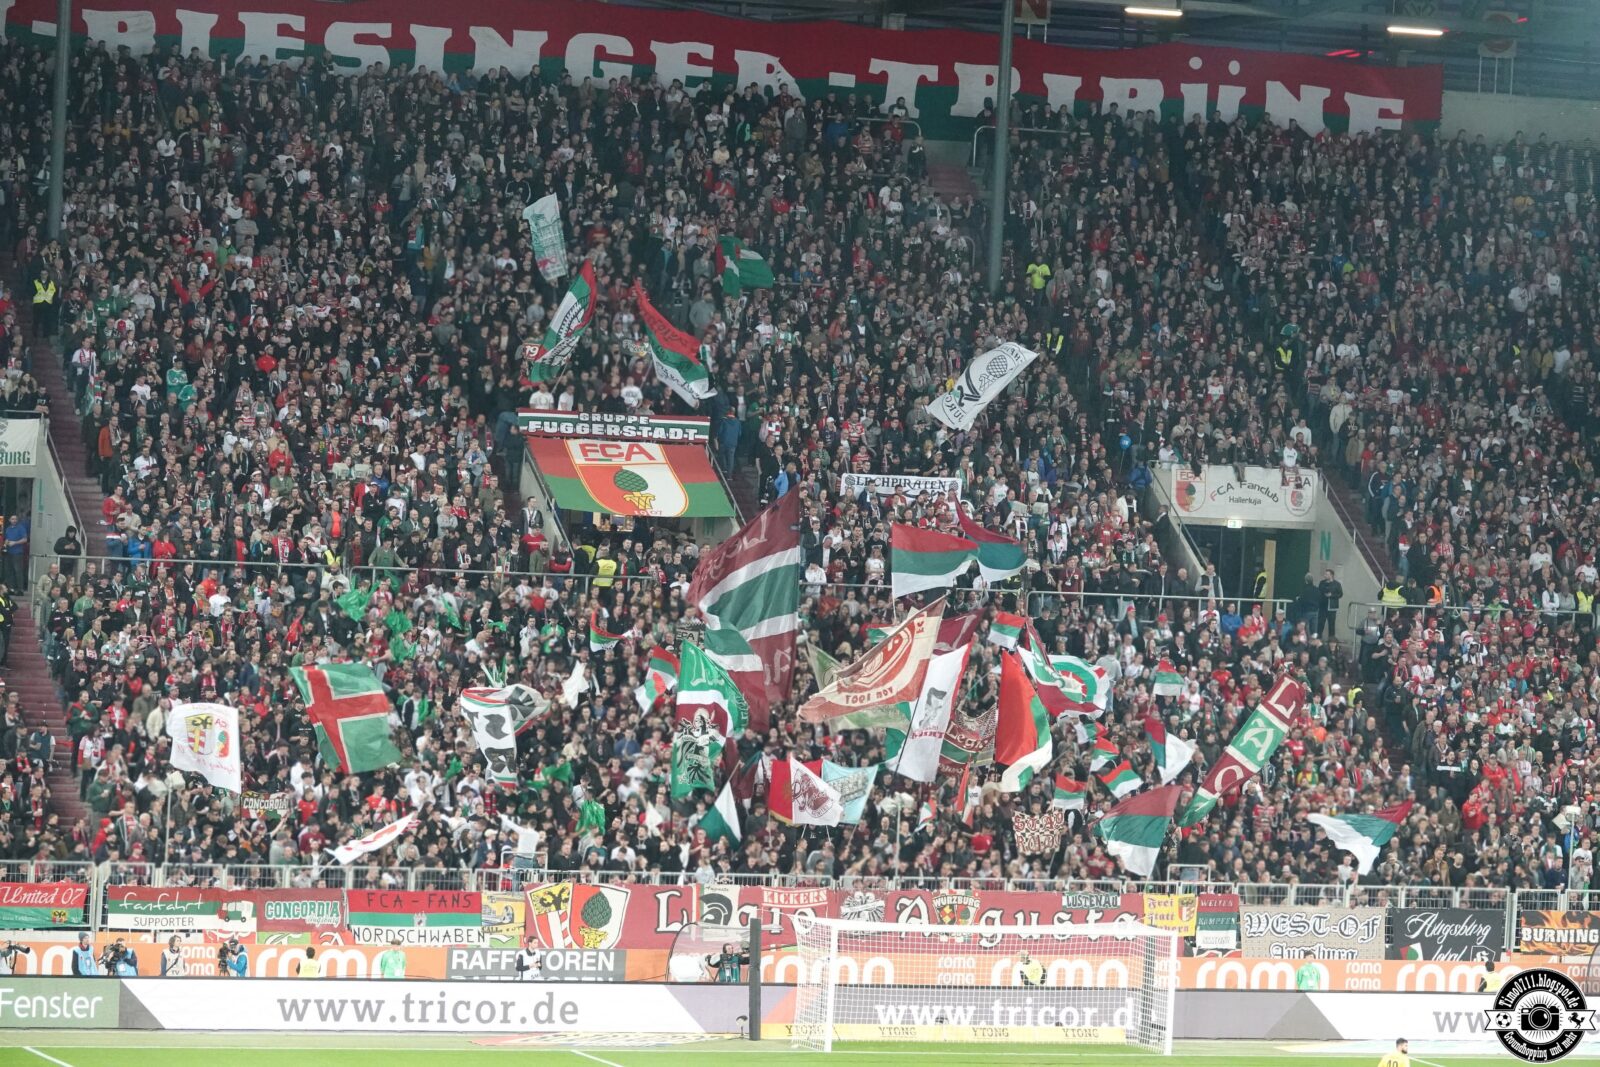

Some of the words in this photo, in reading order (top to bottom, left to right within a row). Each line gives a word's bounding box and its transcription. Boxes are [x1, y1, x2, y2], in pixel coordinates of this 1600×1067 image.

[579, 412, 650, 425] GRUPPE
[528, 420, 698, 441] FUGGERSTADT
[578, 443, 657, 462] FCA
[1238, 481, 1280, 504] Fanclub
[1319, 530, 1332, 561] N
[762, 889, 828, 905] KICKERS
[933, 893, 980, 908] WÜRZBURG
[1065, 894, 1119, 909] LUSTENAU
[264, 900, 341, 920] CONCORDIA
[132, 916, 195, 927] SUPPORTER
[1404, 911, 1493, 945] Augsburg
[352, 926, 486, 944] NORDSCHWABEN
[1521, 927, 1600, 944] BURNING
[1345, 961, 1382, 975] roma
[1345, 976, 1382, 990] roma
[0, 988, 103, 1020] Fenster
[277, 990, 580, 1025] www.tricor.de
[878, 1025, 918, 1037] YTONG
[972, 1026, 1010, 1038] YTONG
[1062, 1027, 1100, 1039] YTONG
